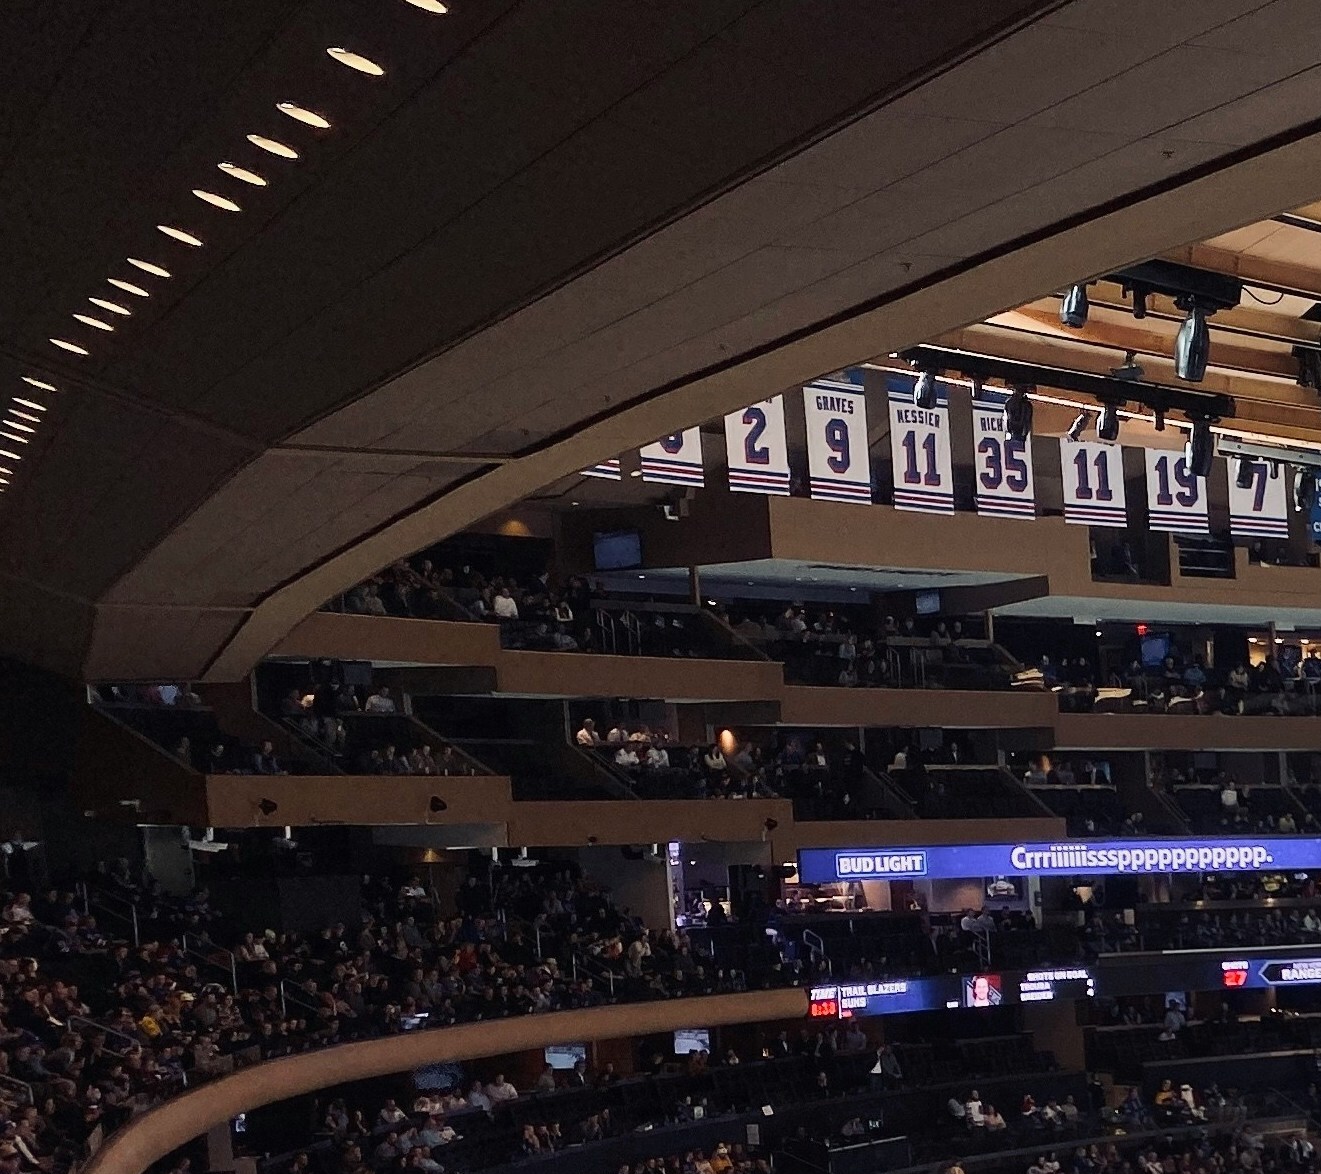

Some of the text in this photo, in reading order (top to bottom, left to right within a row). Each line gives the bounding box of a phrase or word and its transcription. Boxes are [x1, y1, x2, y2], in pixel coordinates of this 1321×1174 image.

[815, 395, 855, 415] GRAVES
[897, 408, 941, 429] MESSIER
[741, 407, 770, 465] 2
[825, 418, 852, 475] 9
[903, 429, 942, 487] 11
[977, 436, 1028, 493] 35
[1072, 448, 1113, 502] 11
[1154, 454, 1199, 508] 19
[839, 854, 924, 875] BUD LIGHT
[1224, 970, 1248, 987] 27
